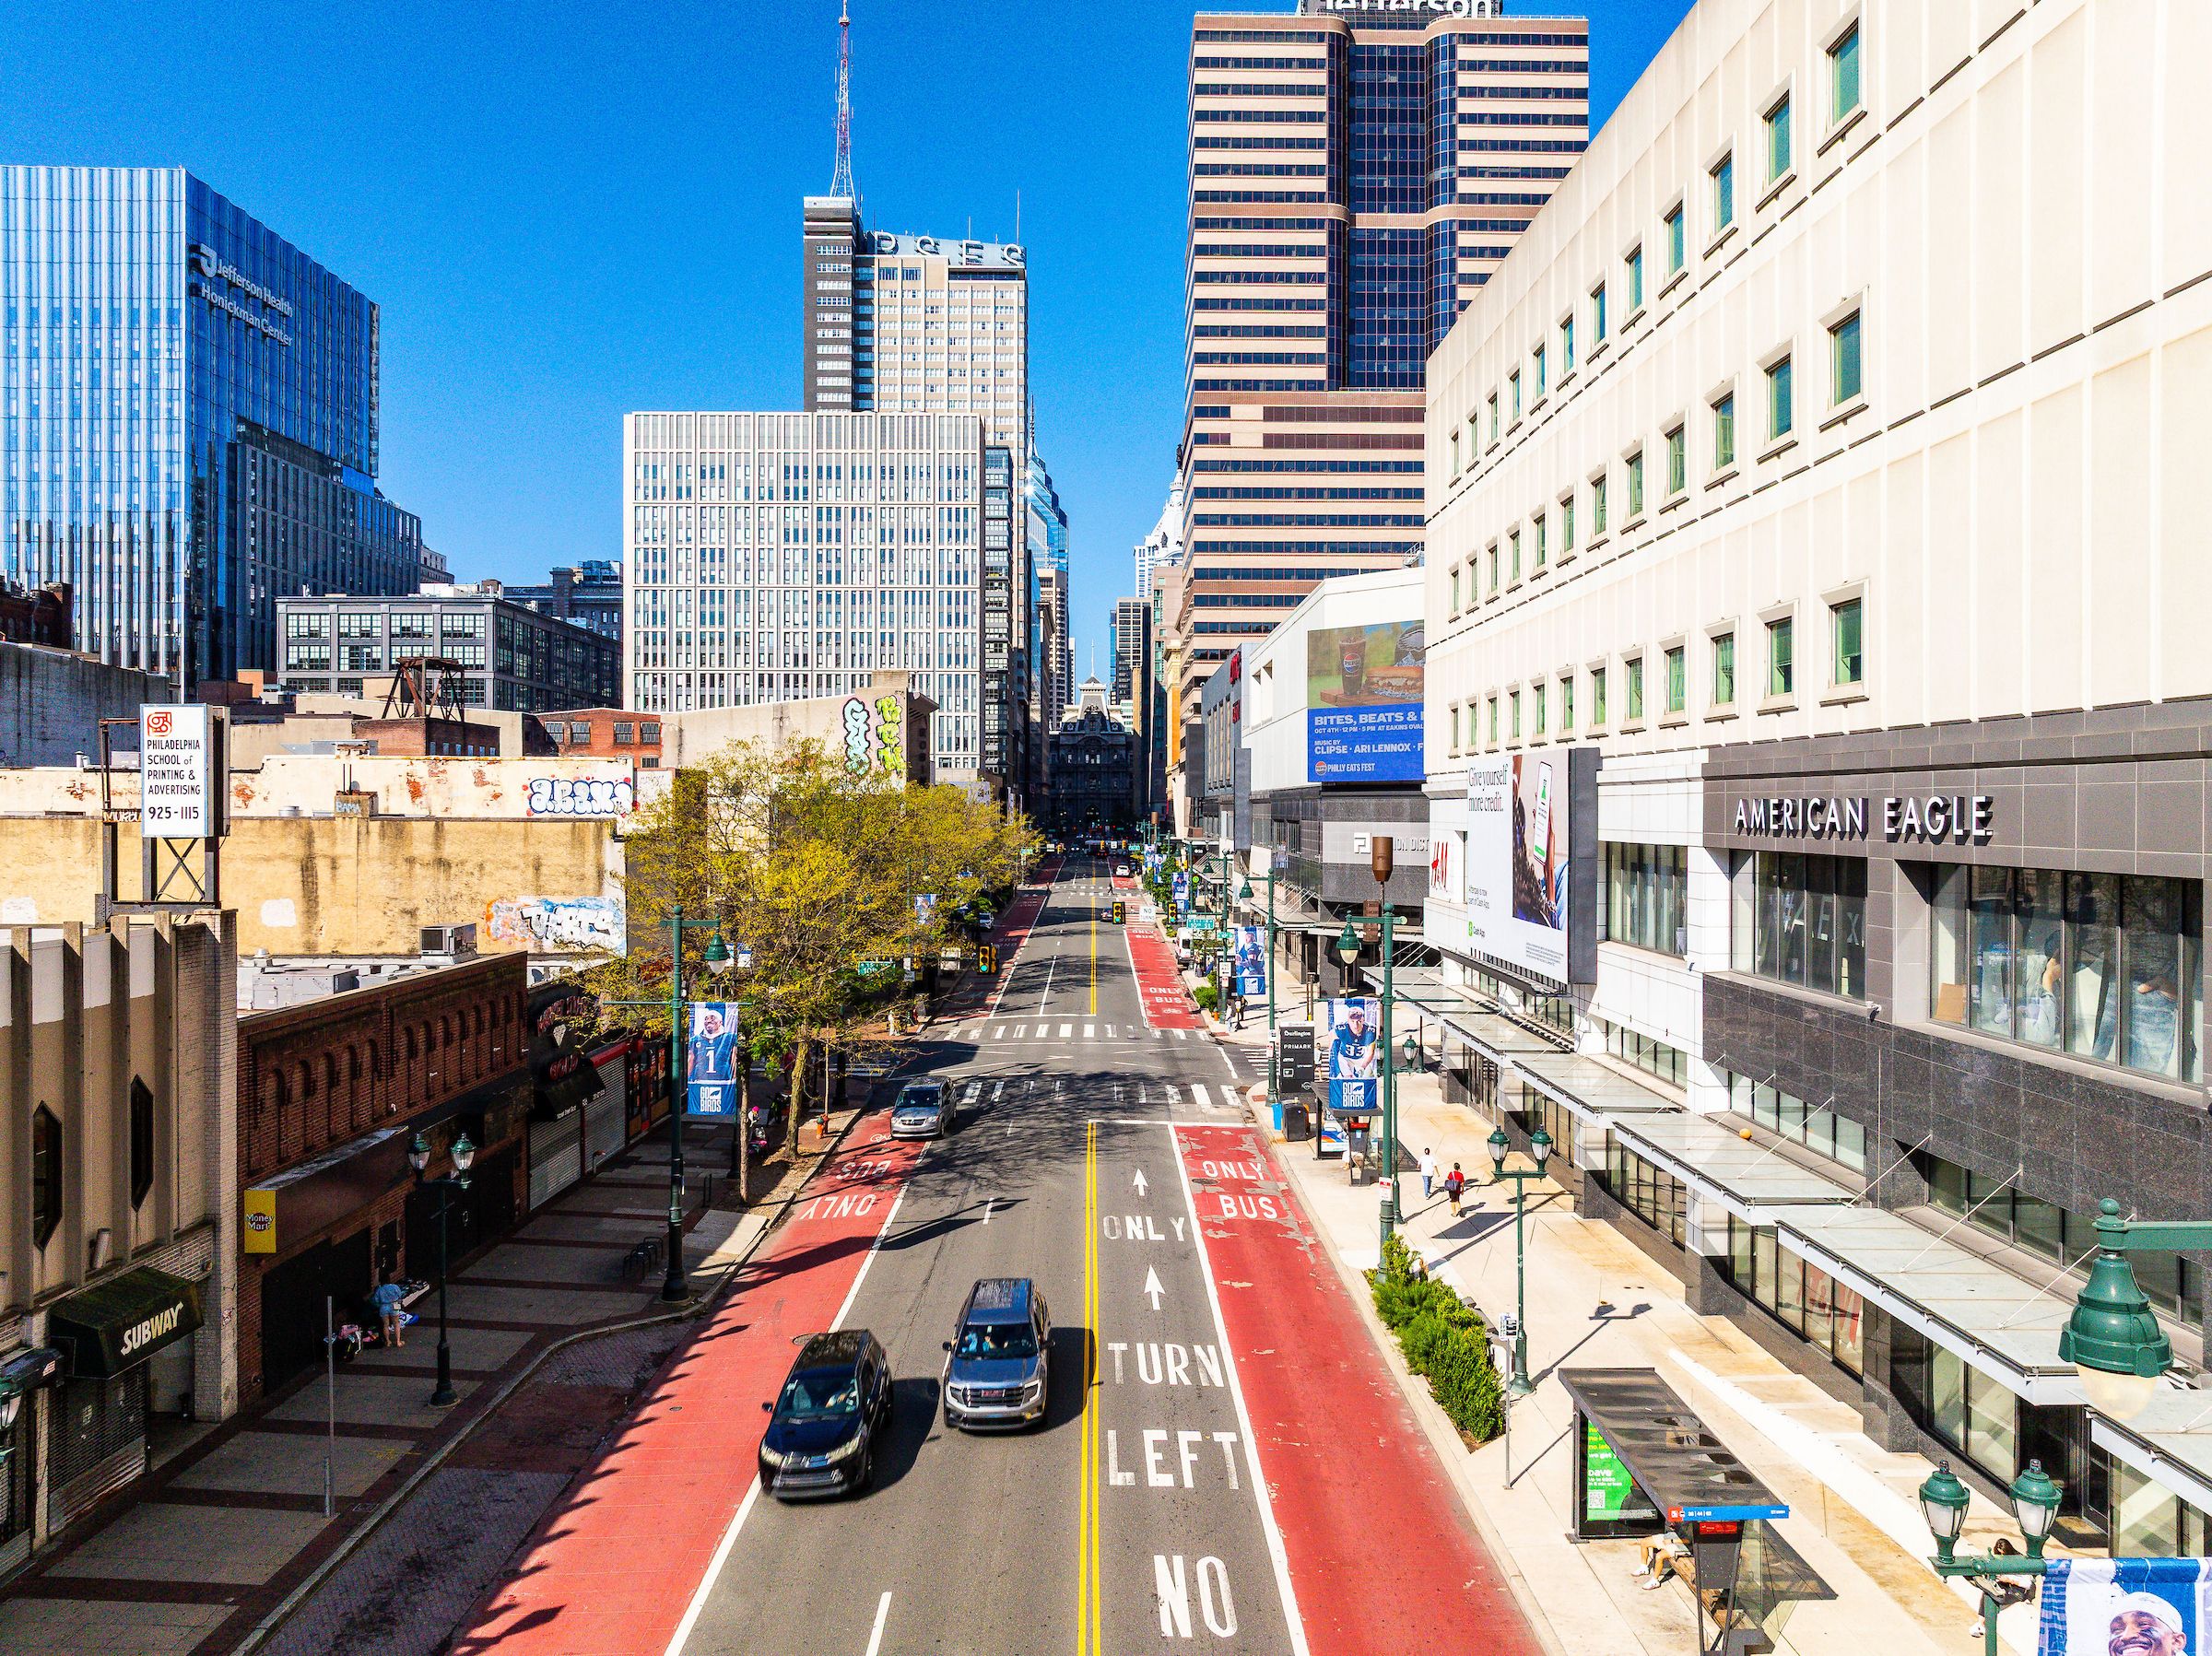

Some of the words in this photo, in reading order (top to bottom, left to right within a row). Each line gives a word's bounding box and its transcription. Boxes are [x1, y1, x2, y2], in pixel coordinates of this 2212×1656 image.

[217, 259, 263, 299] Jefferson
[264, 287, 293, 317] Health
[201, 282, 260, 329] Honickman
[261, 319, 293, 346] Center
[1314, 715, 1357, 726] BITES,
[1359, 712, 1405, 724] BEATS
[1406, 711, 1418, 722] &
[147, 739, 200, 750] PHILADELPHIA
[1314, 745, 1348, 755] CLIPSE
[1354, 744, 1371, 754] ARI
[1372, 743, 1411, 753] LENNOX
[147, 755, 181, 765] SCHOOL
[183, 755, 194, 765] of
[1327, 763, 1345, 772] PHILLY
[1346, 763, 1360, 772] EATS
[1360, 763, 1375, 771] FEST
[147, 769, 184, 780] PRINTING
[188, 769, 195, 781] &
[1468, 767, 1482, 787] Give
[1482, 763, 1509, 792] yourself
[147, 784, 201, 795] ADVERTISING
[1468, 796, 1484, 812] more
[148, 806, 199, 819] 925-1115
[1734, 797, 1868, 835] AMERICAN
[1883, 795, 1993, 838] EAGLE
[1345, 1045, 1365, 1057] 33
[700, 1086, 711, 1099] GO
[1342, 1082, 1353, 1095] GO
[700, 1098, 722, 1113] BIRDS
[1342, 1094, 1365, 1108] BIRDS
[1202, 1160, 1265, 1180] ONLY
[800, 1193, 877, 1220] ONLY
[1218, 1194, 1278, 1219] BUS
[246, 1213, 275, 1223] Money
[247, 1221, 272, 1230] Mart
[1102, 1215, 1186, 1241] ONLY
[121, 1301, 184, 1357] SUBWAY
[1107, 1342, 1225, 1389] TURN
[1106, 1428, 1241, 1491] LEFT
[1153, 1554, 1239, 1638] NO
